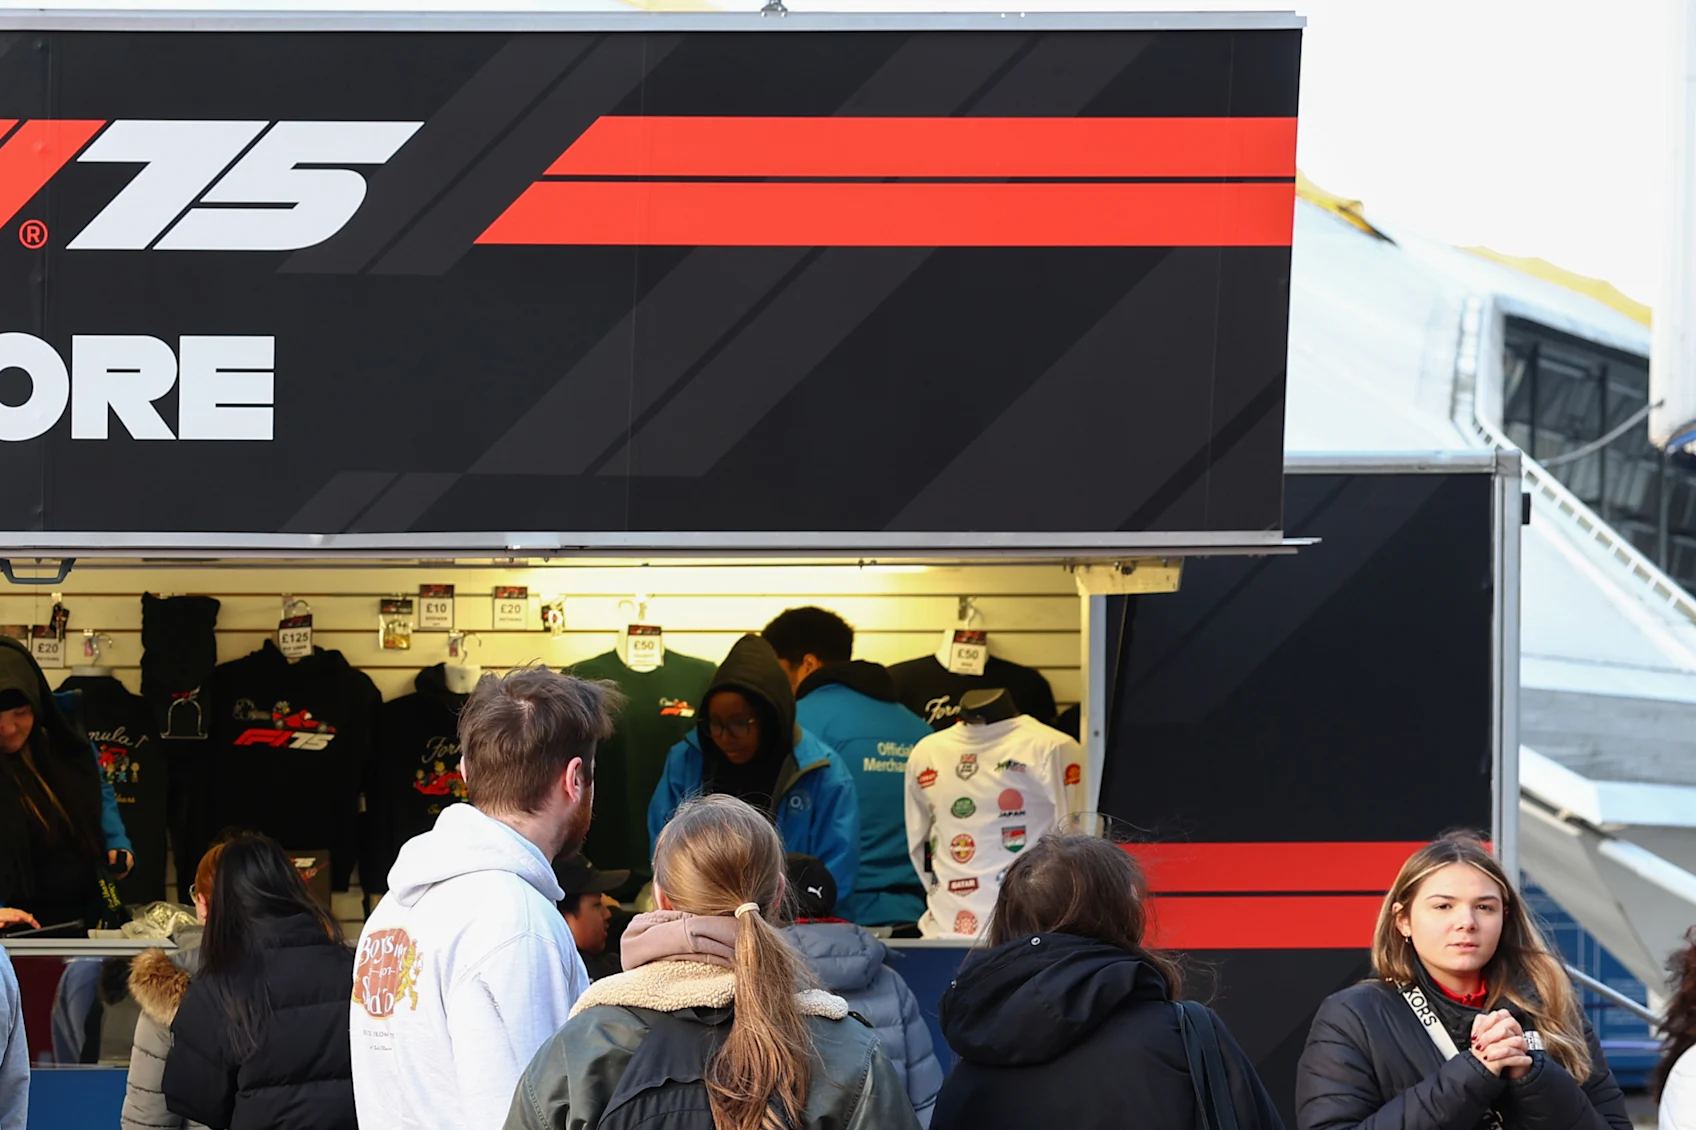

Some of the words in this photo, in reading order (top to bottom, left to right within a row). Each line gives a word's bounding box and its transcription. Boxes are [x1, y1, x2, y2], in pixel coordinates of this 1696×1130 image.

[426, 602, 447, 614] £10
[500, 604, 521, 614] £20
[281, 631, 309, 644] £125
[38, 643, 59, 654] £20
[634, 640, 655, 650] £50
[957, 648, 980, 661] £50
[1405, 986, 1438, 1027] KORS
